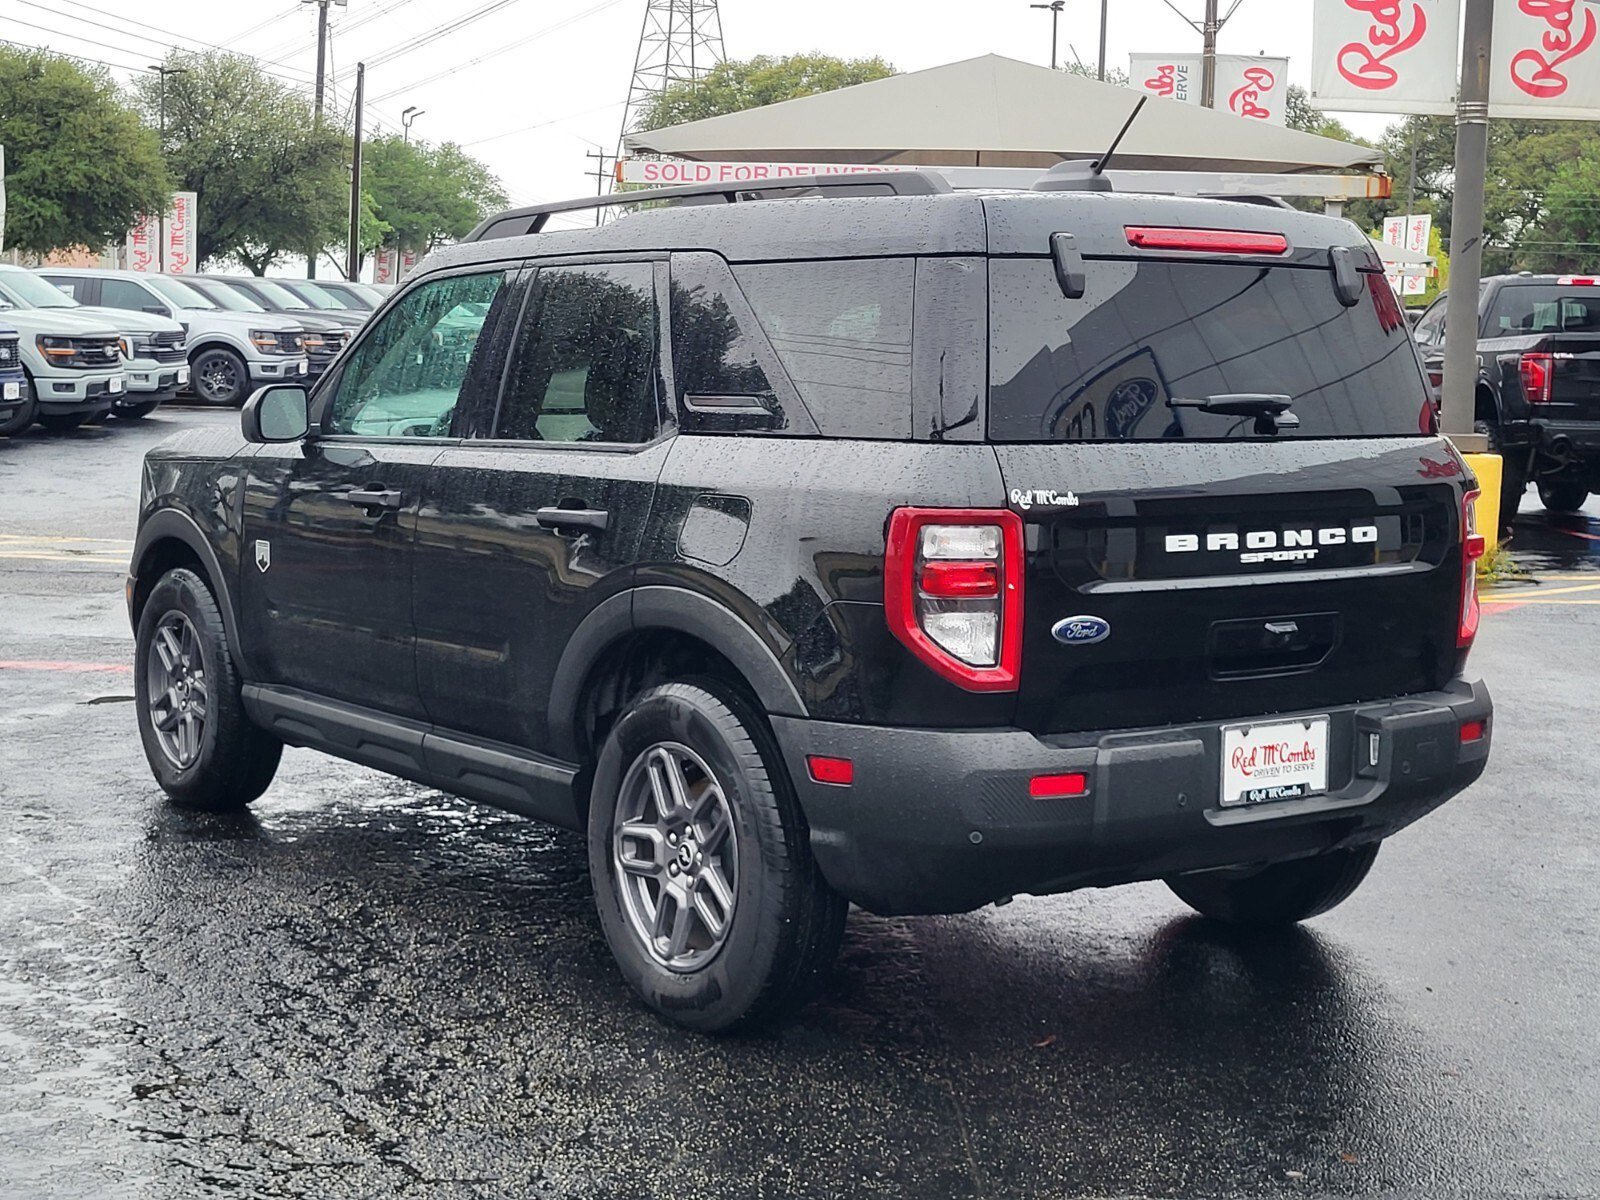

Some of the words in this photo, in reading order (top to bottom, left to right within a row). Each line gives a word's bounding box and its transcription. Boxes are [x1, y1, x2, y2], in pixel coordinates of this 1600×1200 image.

[1337, 0, 1427, 90] Red
[1510, 0, 1597, 98] Red
[1176, 65, 1188, 101] ERVE
[1229, 67, 1274, 119] Red
[644, 164, 712, 182] SOLD
[720, 165, 769, 181] FOR
[169, 252, 189, 274] Red
[1010, 488, 1033, 510] Red
[1032, 489, 1079, 506] McCombs
[1165, 525, 1378, 553] BRONCO
[1240, 549, 1319, 564] SPORT
[1231, 746, 1257, 776] Red
[1260, 741, 1316, 766] McCombs
[1253, 766, 1281, 778] DRIVEN
[1282, 765, 1292, 774] TO
[1293, 762, 1315, 772] SERVE
[1250, 789, 1267, 802] Red
